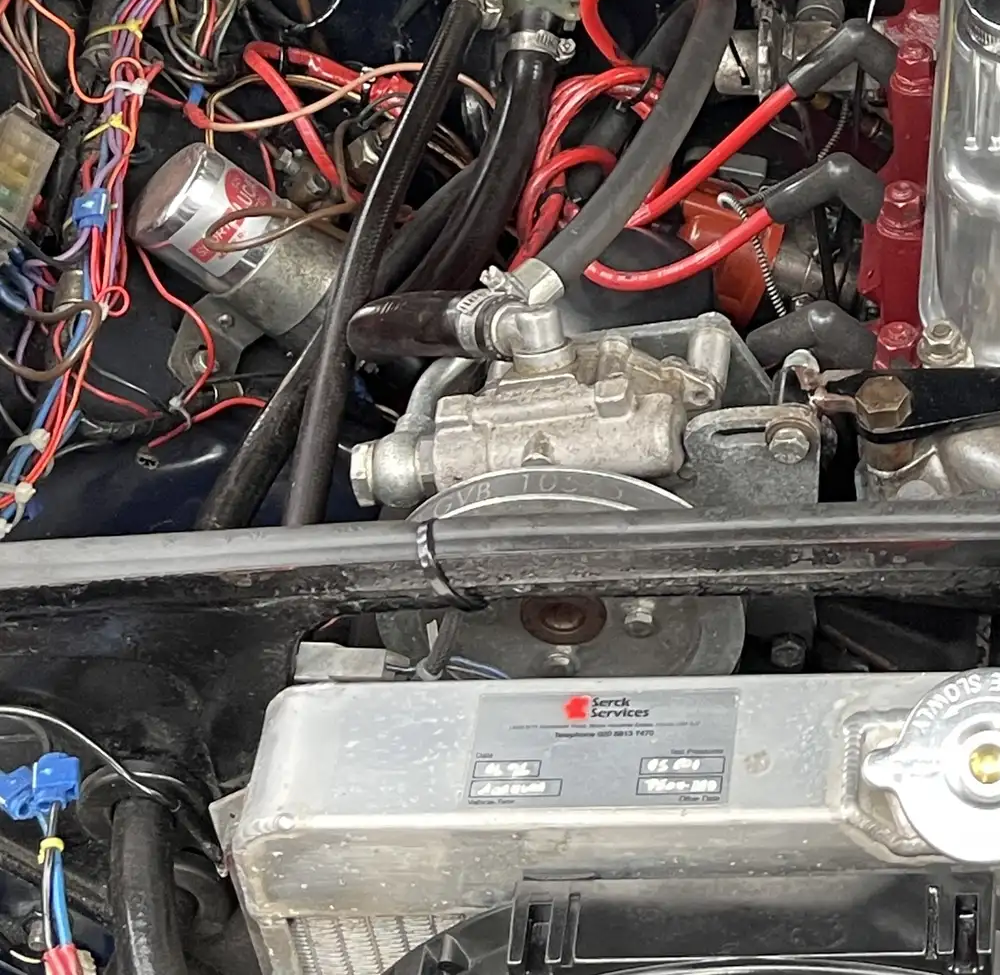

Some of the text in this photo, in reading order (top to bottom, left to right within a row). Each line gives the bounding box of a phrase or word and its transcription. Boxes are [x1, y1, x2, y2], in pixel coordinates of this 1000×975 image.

[591, 696, 631, 708] Serck
[910, 673, 982, 734] SLOWLY
[590, 707, 650, 719] Services
